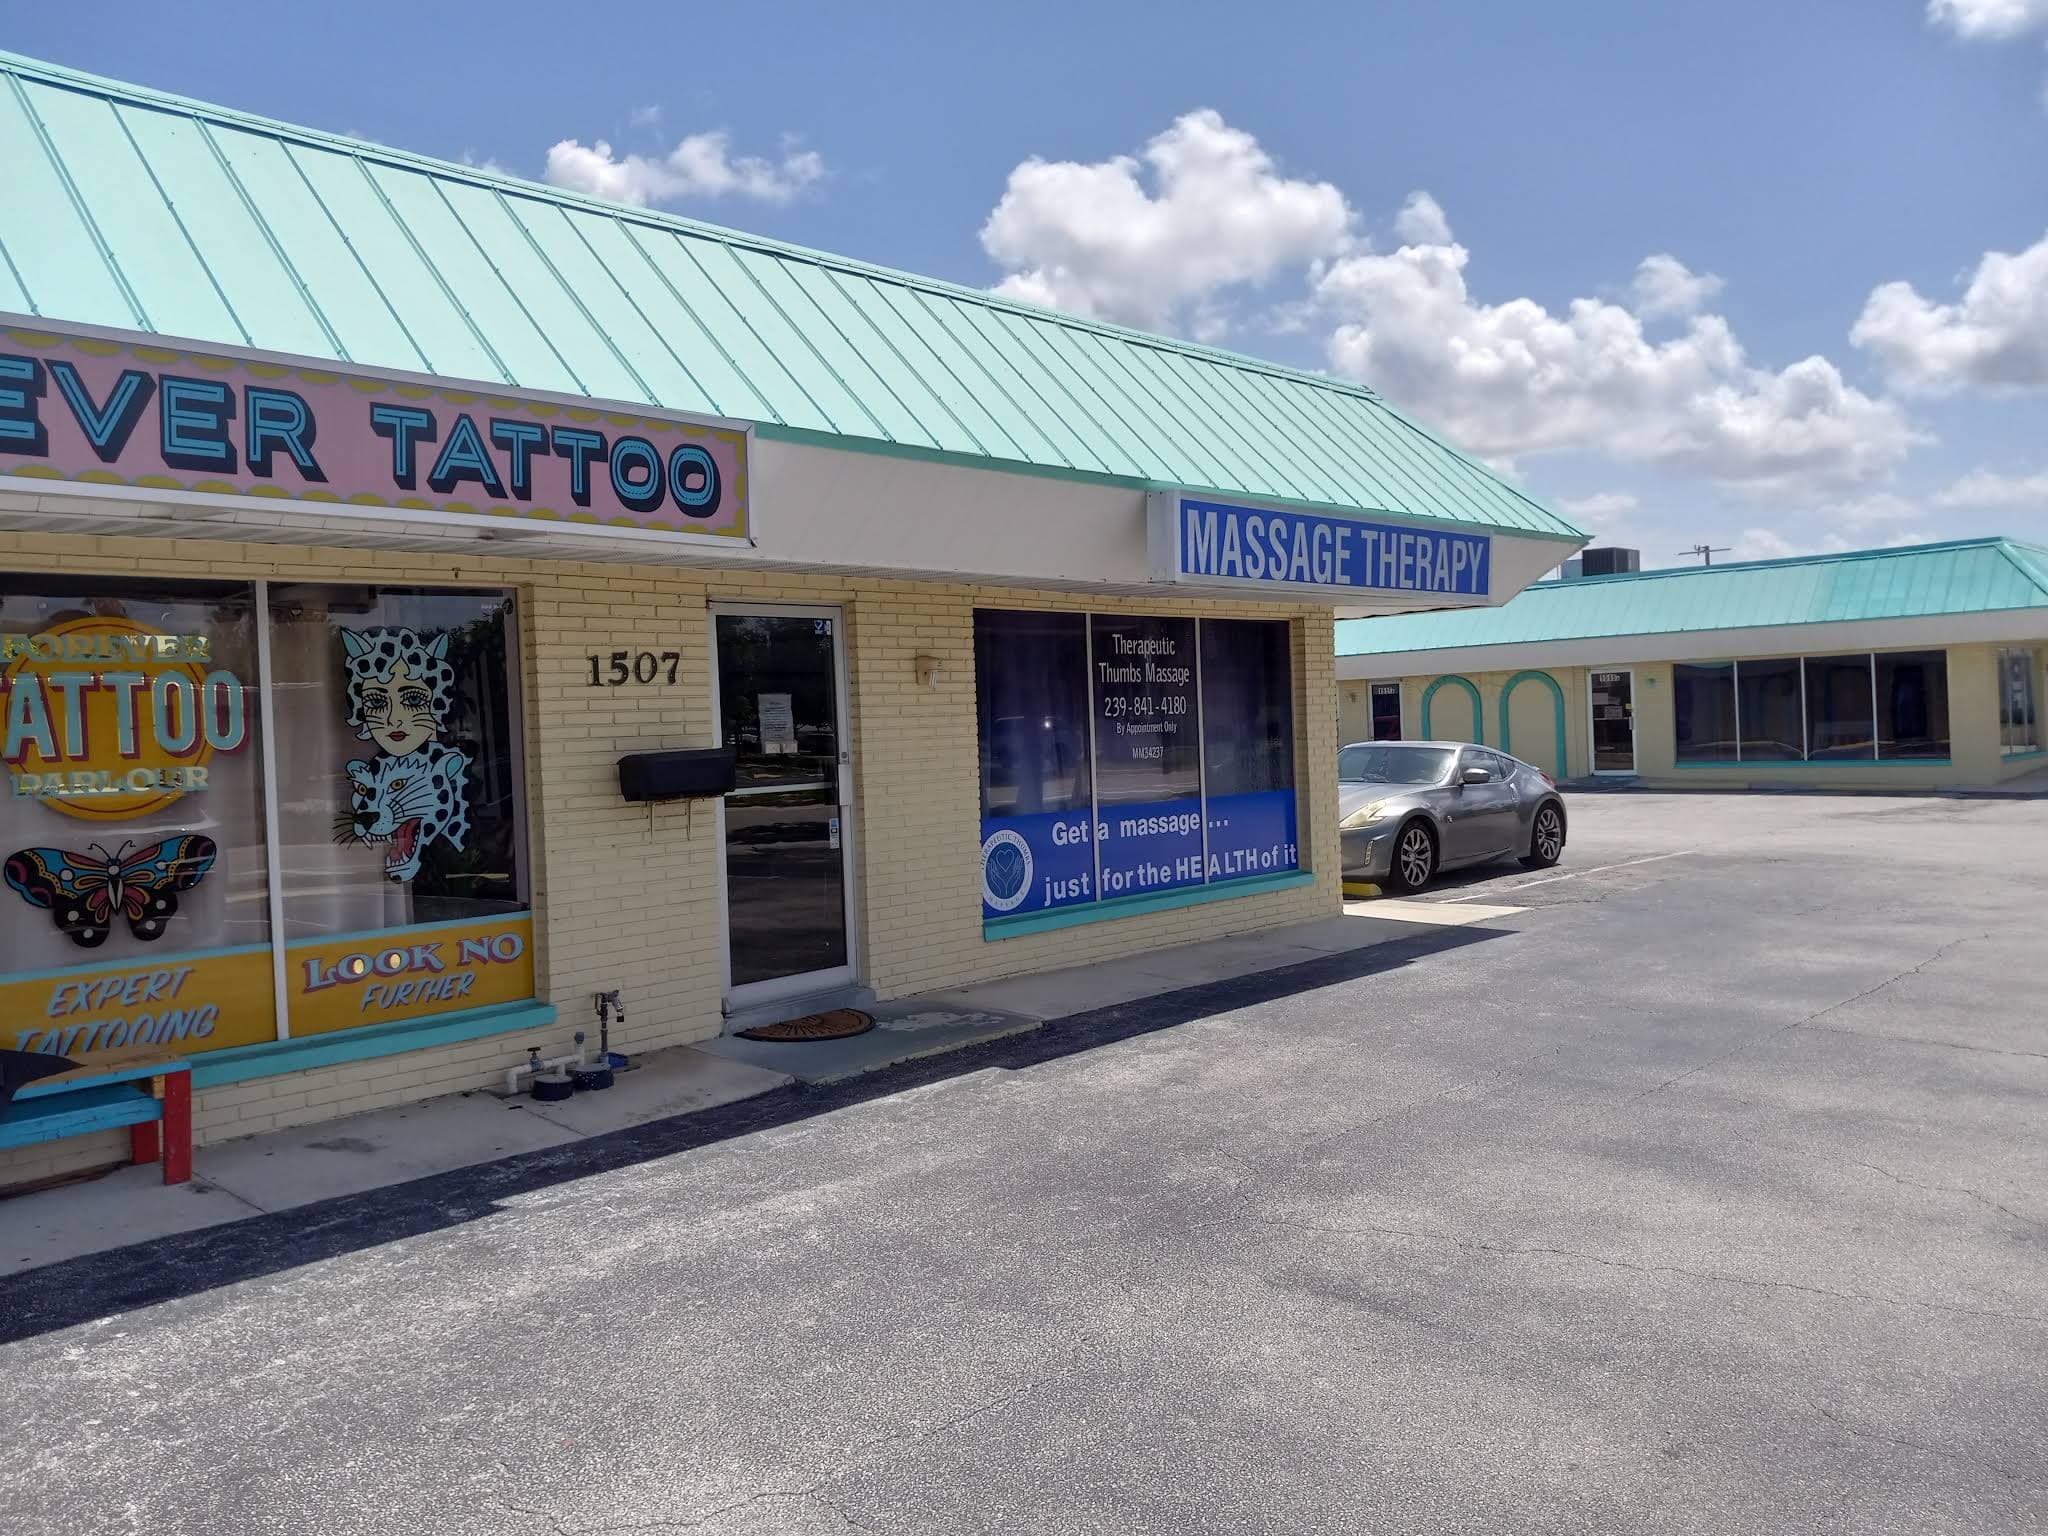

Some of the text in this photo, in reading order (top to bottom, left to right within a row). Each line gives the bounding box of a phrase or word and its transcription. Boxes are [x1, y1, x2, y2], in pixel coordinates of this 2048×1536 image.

[370, 402, 720, 518] TATTOO
[1187, 508, 1484, 593] MASSAGE THERAPY
[0, 633, 212, 663] FOREVER
[1112, 634, 1176, 659] Therapeutic
[585, 651, 680, 686] 1507
[1099, 662, 1190, 686] Thumbs Massage
[0, 670, 250, 764] ATTOO
[1104, 696, 1187, 717] 239-841-4180
[1116, 721, 1177, 735] By Appointment Only
[10, 766, 208, 800] PARLOUR
[1052, 820, 1088, 846] Get
[1098, 822, 1109, 841] a
[1044, 870, 1090, 907] just
[1102, 867, 1134, 892] for
[1137, 862, 1172, 886] the
[1261, 844, 1279, 868] of
[1284, 843, 1297, 865] it
[302, 932, 525, 994] LOOK NO
[47, 966, 195, 1018] EXPERT
[360, 970, 476, 1013] FURTHER
[14, 1002, 220, 1056] TATTOOING
